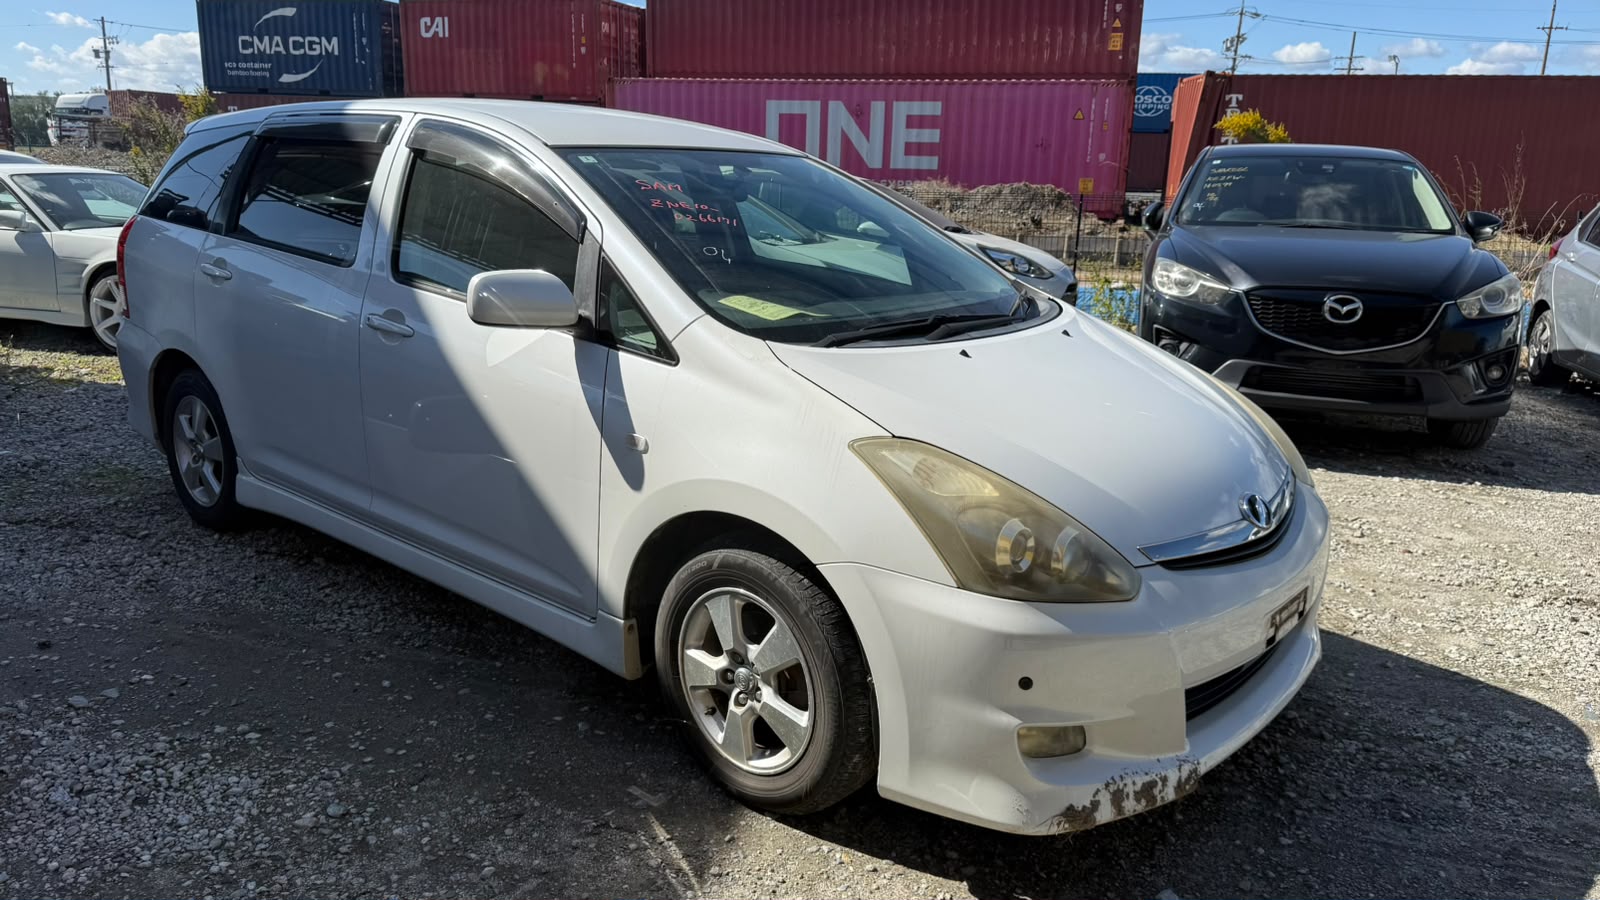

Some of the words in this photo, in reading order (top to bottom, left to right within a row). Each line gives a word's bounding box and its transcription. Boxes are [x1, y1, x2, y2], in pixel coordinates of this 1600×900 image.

[420, 16, 449, 38] CAI
[238, 35, 285, 55] CMA
[289, 36, 339, 56] CGM
[1134, 94, 1172, 104] OSCO
[765, 99, 943, 170] ONE
[635, 179, 684, 193] SAM
